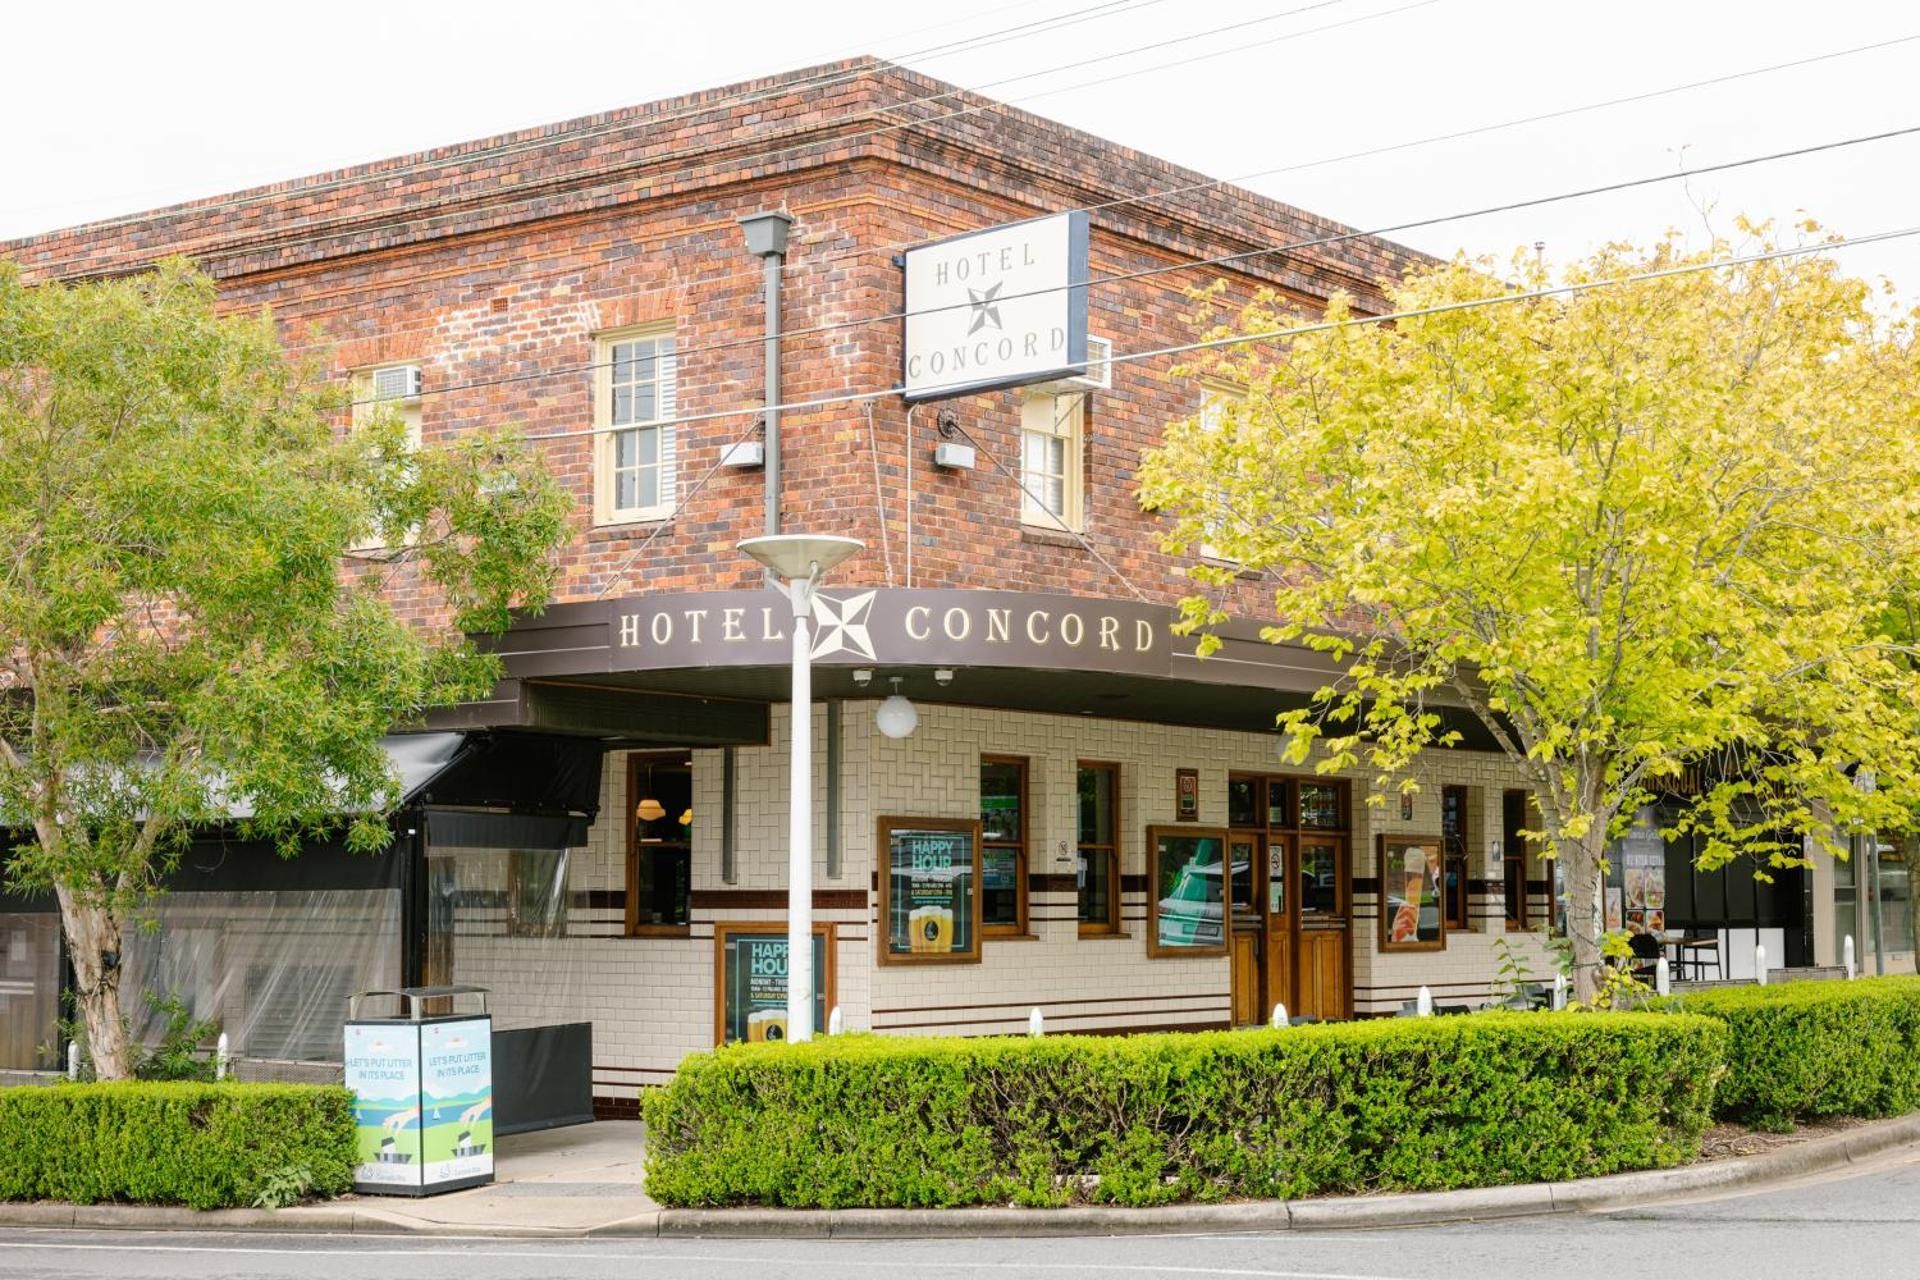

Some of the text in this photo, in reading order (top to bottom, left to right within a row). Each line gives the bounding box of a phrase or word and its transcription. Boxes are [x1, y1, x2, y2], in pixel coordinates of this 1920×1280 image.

[936, 243, 1036, 286] HOTEL
[908, 327, 1065, 379] CONCORD
[619, 605, 1154, 652] HOTEL CONCORD
[912, 840, 953, 855] HAPPY
[912, 855, 951, 870] HOUR
[752, 943, 790, 957] HAPP
[751, 958, 789, 974] HOU
[370, 1058, 385, 1067] PUT
[387, 1059, 412, 1067] LITTER
[449, 1055, 461, 1064] PUT
[463, 1052, 486, 1062] LITTER
[360, 1071, 405, 1080] IN ITS PLACE
[446, 1068, 457, 1076] ITS
[458, 1065, 480, 1074] PLACE
